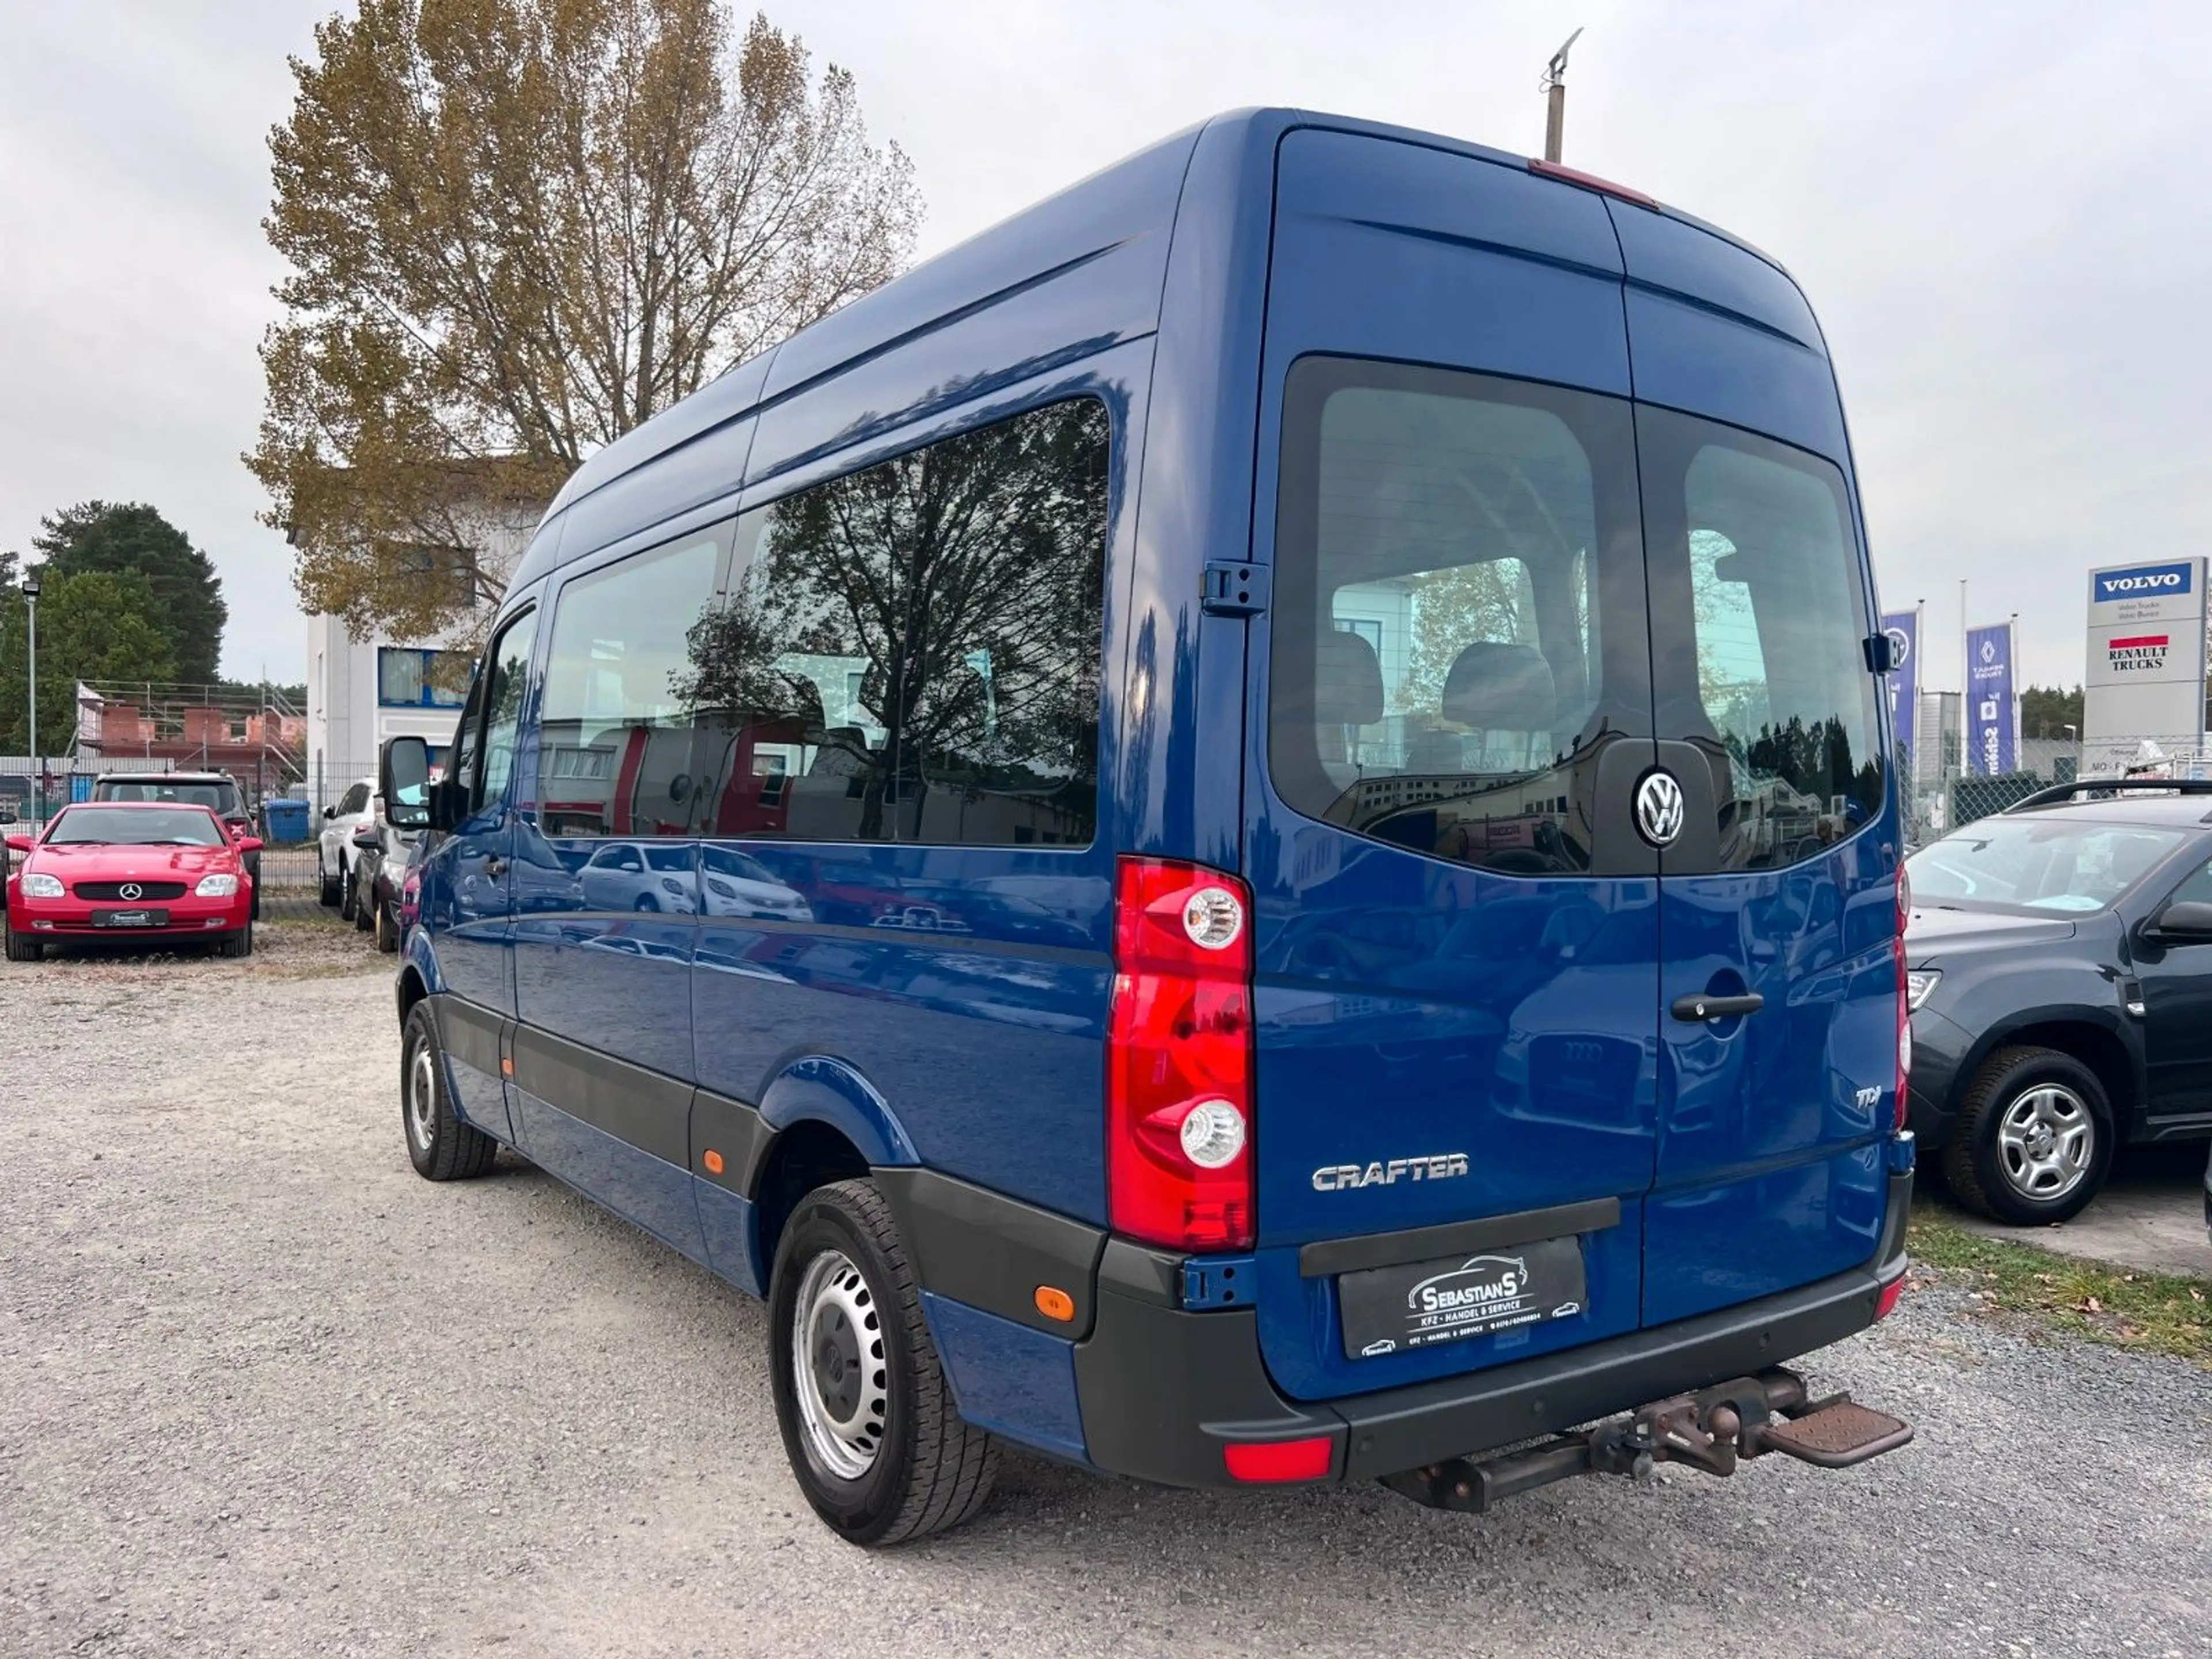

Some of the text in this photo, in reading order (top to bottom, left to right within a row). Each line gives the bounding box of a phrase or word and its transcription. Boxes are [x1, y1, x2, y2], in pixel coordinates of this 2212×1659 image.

[2103, 573, 2181, 592] VOLVO
[2109, 646, 2168, 660] RENAULT
[2113, 658, 2163, 671] TRUCKS
[1312, 1152, 1470, 1192] CRAFTER
[1421, 1315, 1439, 1327] KFZ
[1445, 1308, 1479, 1323] HANDEL
[1488, 1299, 1521, 1314] SERVICE
